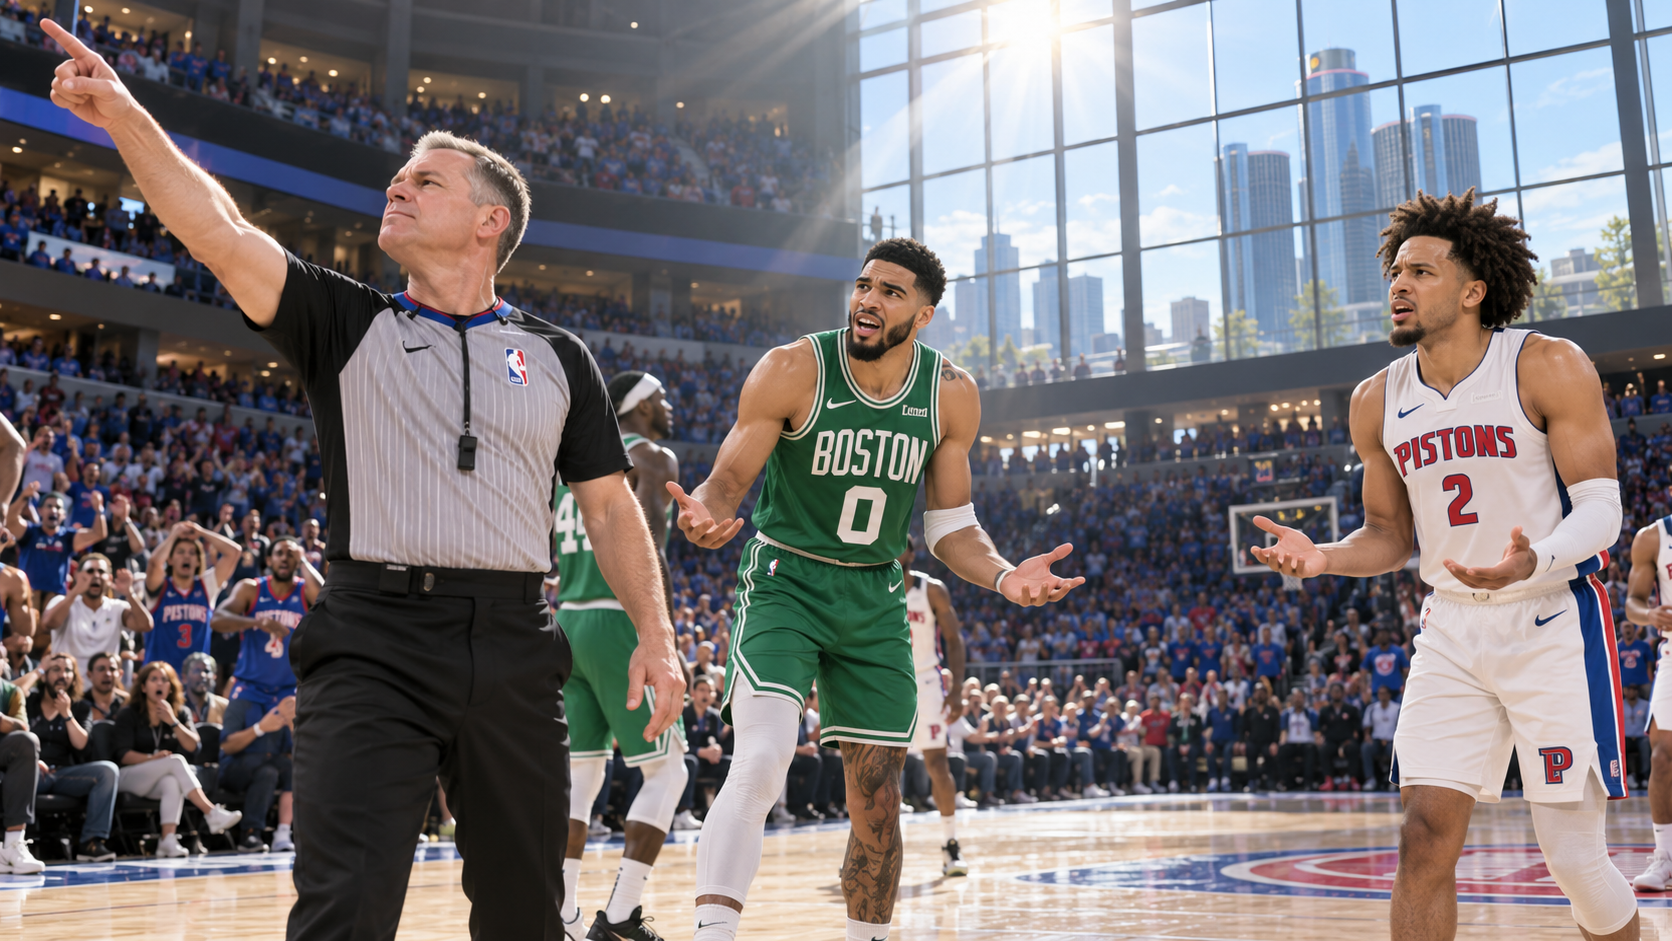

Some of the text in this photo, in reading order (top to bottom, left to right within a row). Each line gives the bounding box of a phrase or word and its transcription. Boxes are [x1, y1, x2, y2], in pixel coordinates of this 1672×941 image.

[811, 428, 928, 485] BOSTON
[1393, 425, 1517, 478] PISTONS
[836, 485, 888, 546] 0
[1442, 473, 1479, 527] 2
[162, 603, 207, 623] PISTONS
[177, 623, 192, 648] 3
[1538, 745, 1574, 784] P
